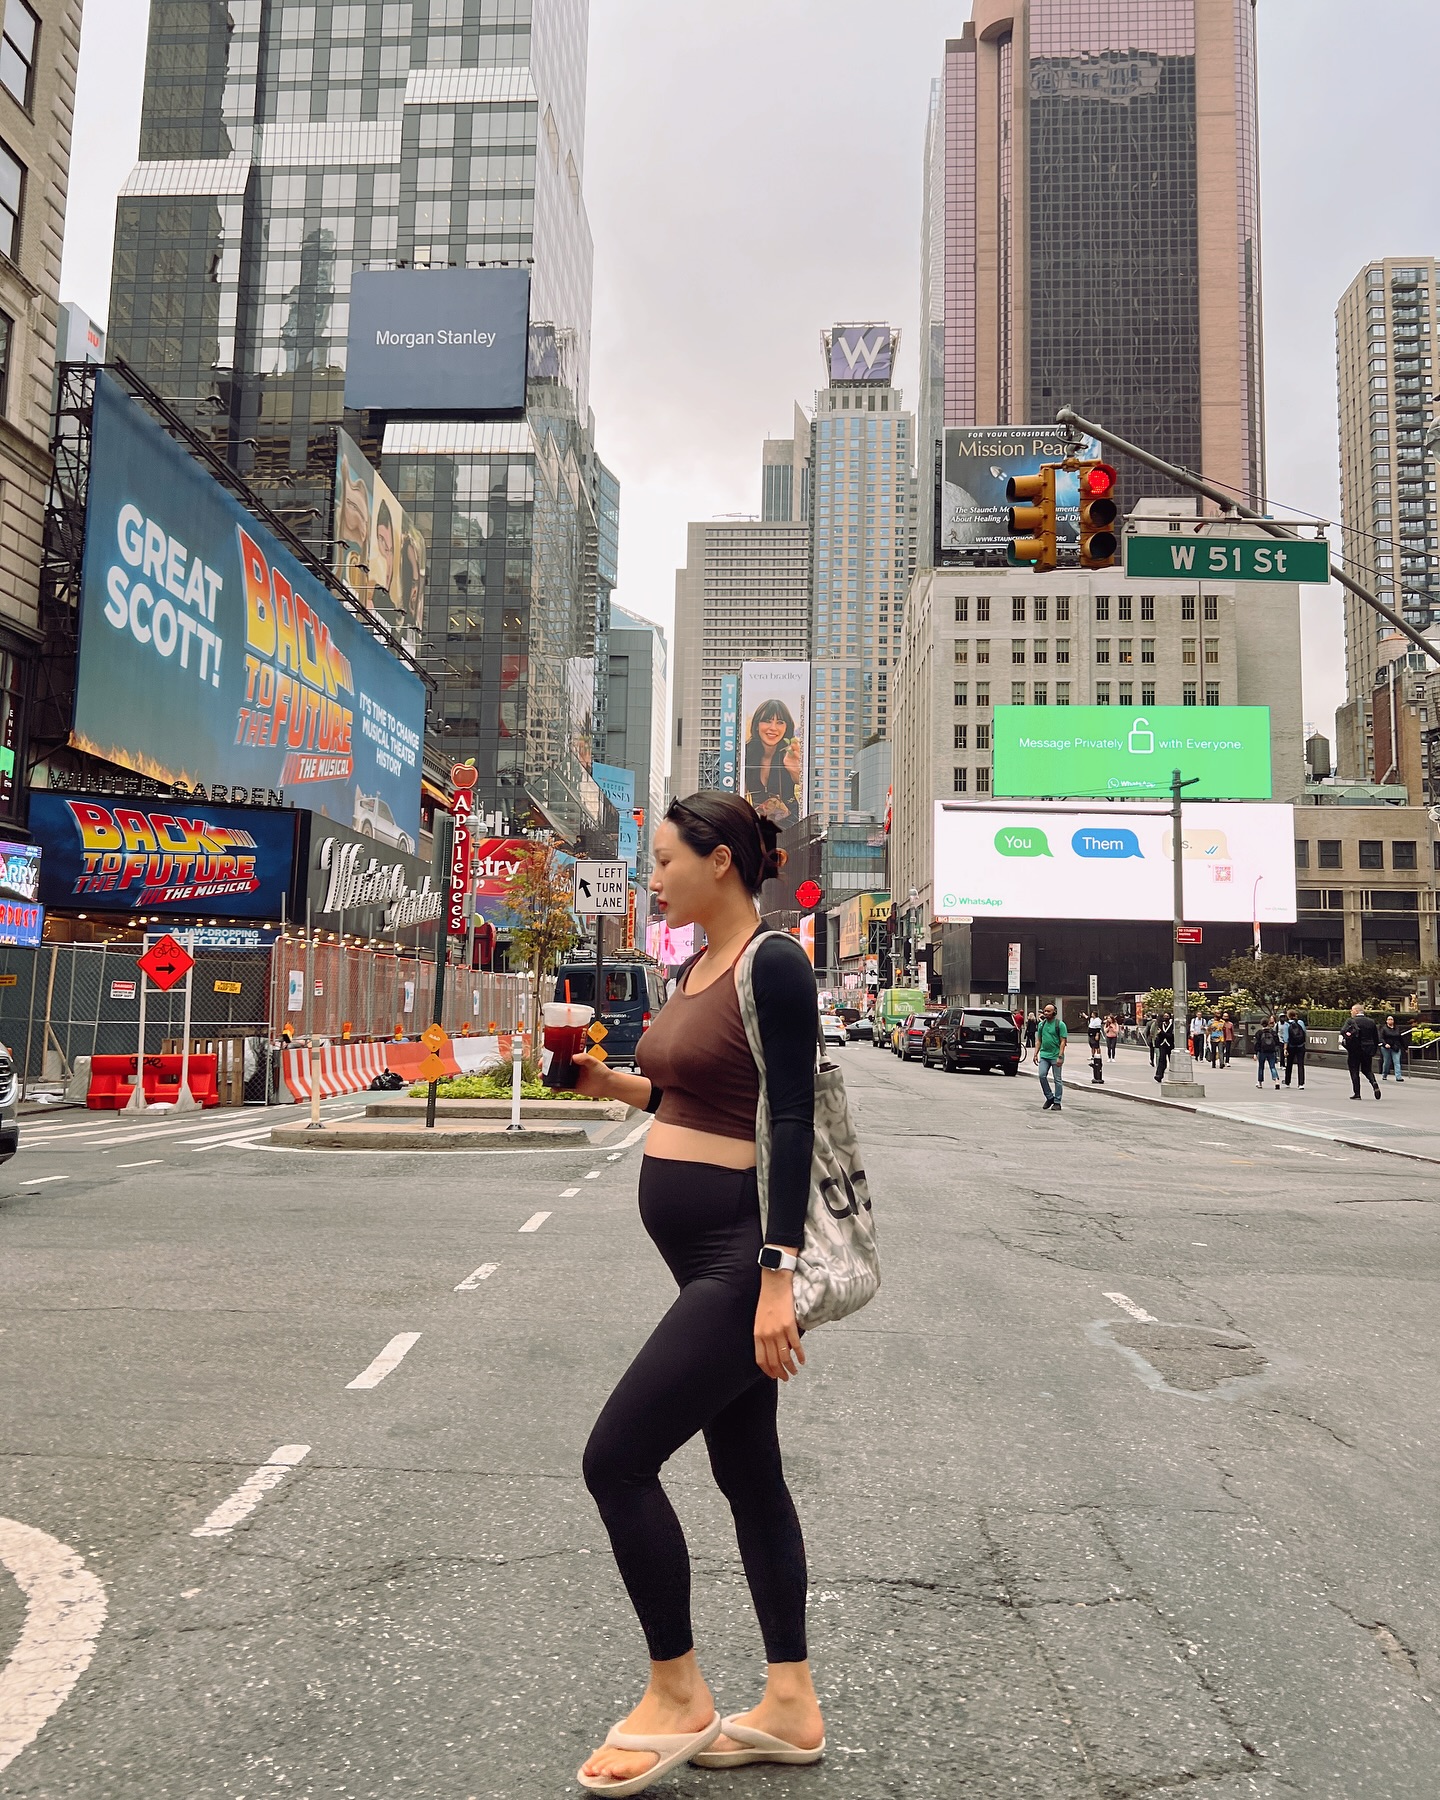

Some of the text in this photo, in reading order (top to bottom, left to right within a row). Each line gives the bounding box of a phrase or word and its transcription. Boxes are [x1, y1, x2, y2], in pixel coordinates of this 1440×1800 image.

[376, 329, 496, 349] Morgan Stanley
[838, 336, 885, 370] W
[958, 440, 1025, 457] Mission
[955, 506, 968, 514] The
[970, 506, 998, 514] Staunch
[974, 515, 1001, 523] Healing
[117, 504, 223, 623] GREAT
[1170, 545, 1287, 573] W 51 St
[236, 523, 340, 699] BACK
[104, 566, 223, 688] SCOTT!
[770, 672, 803, 681] bradley
[235, 653, 353, 754] TO THE FUTURE
[360, 691, 420, 750] IT'S TIME TO CHANGE
[362, 716, 416, 768] MUSICAL THEATER
[722, 684, 736, 794] TIMES SQ
[1019, 737, 1244, 751] Message Privately with Everyone.
[299, 757, 349, 779] THE MUSICAL
[376, 747, 402, 776] HISTORY
[50, 770, 284, 807] WINTER GARDEN
[68, 799, 226, 855] BACK
[1003, 835, 1032, 849] You
[1081, 836, 1124, 850] Them
[75, 852, 257, 893] TO THE FUTURE
[320, 837, 392, 914] Winter
[598, 867, 622, 878] LEFT
[163, 880, 252, 901] THE MUSICAL
[596, 882, 622, 893] TURN
[595, 897, 622, 908] LANE
[959, 897, 1003, 907] WhatsApp
